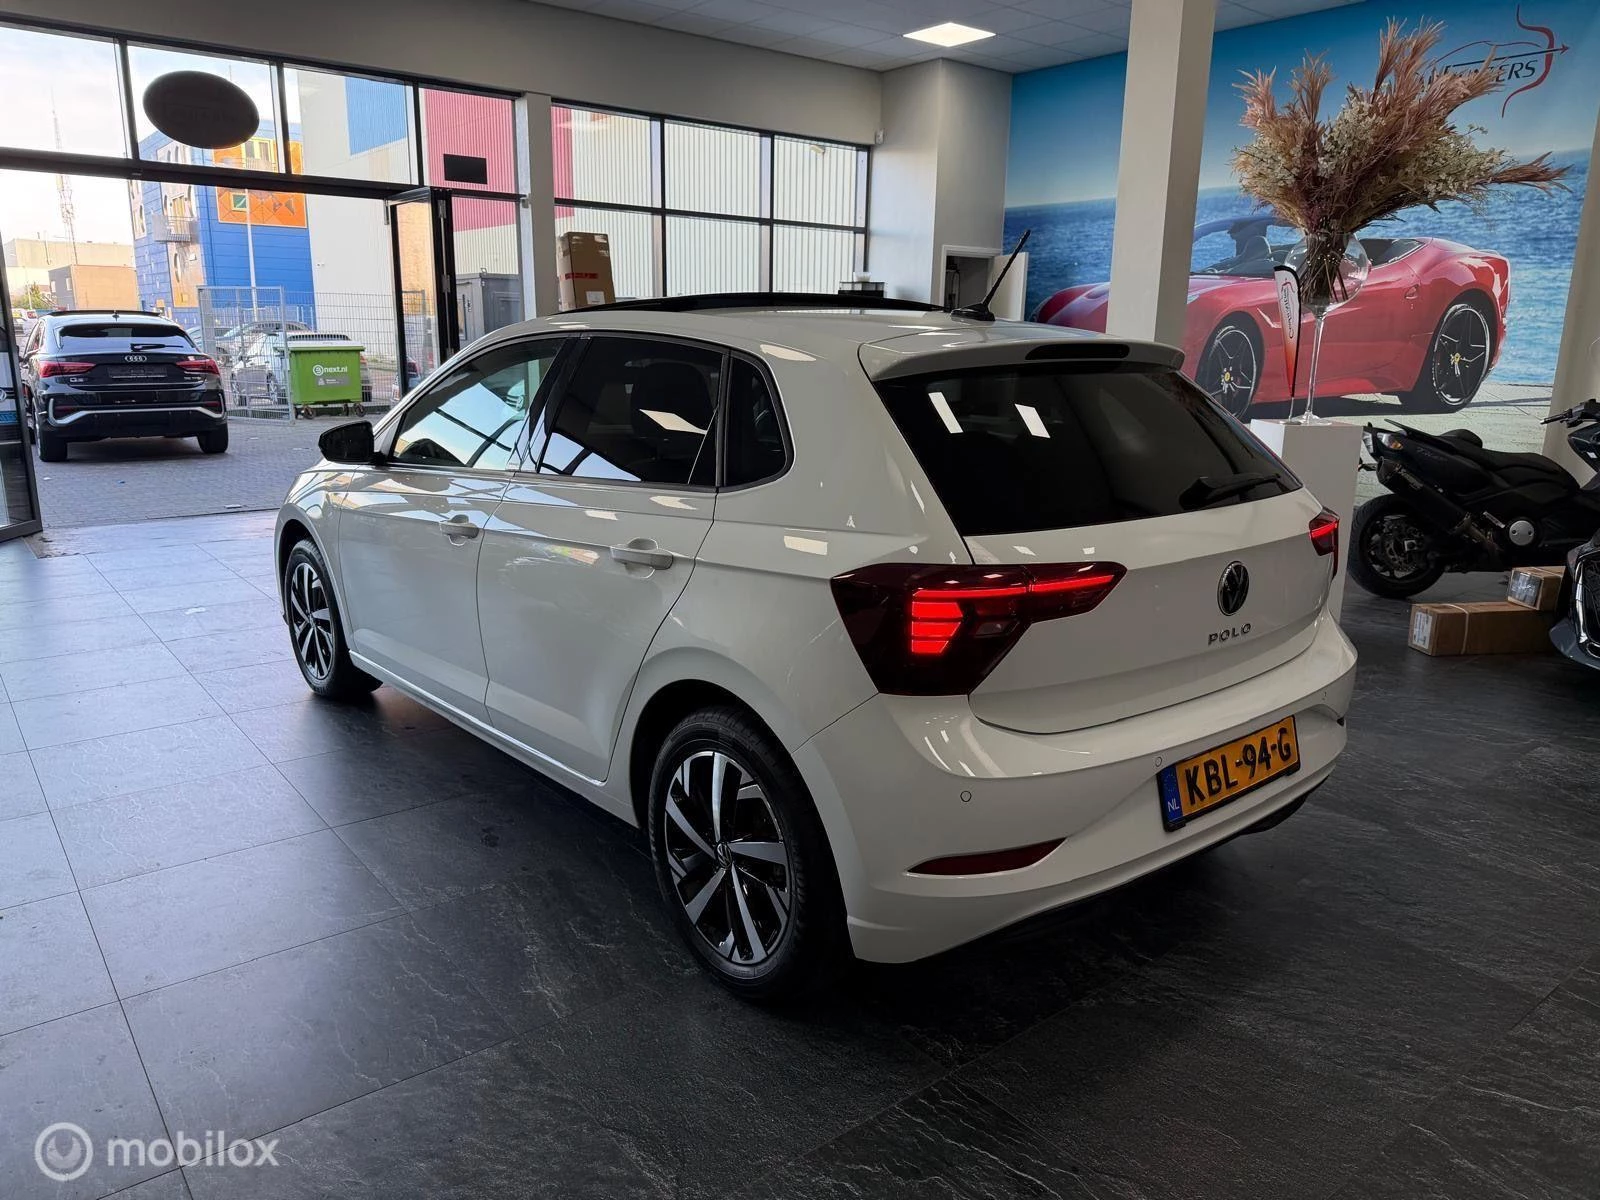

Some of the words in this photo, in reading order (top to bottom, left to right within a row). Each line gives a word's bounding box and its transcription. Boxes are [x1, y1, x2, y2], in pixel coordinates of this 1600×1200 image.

[1208, 623, 1251, 646] POLO
[1185, 727, 1292, 806] KBL-94-G
[1167, 798, 1180, 812] NL
